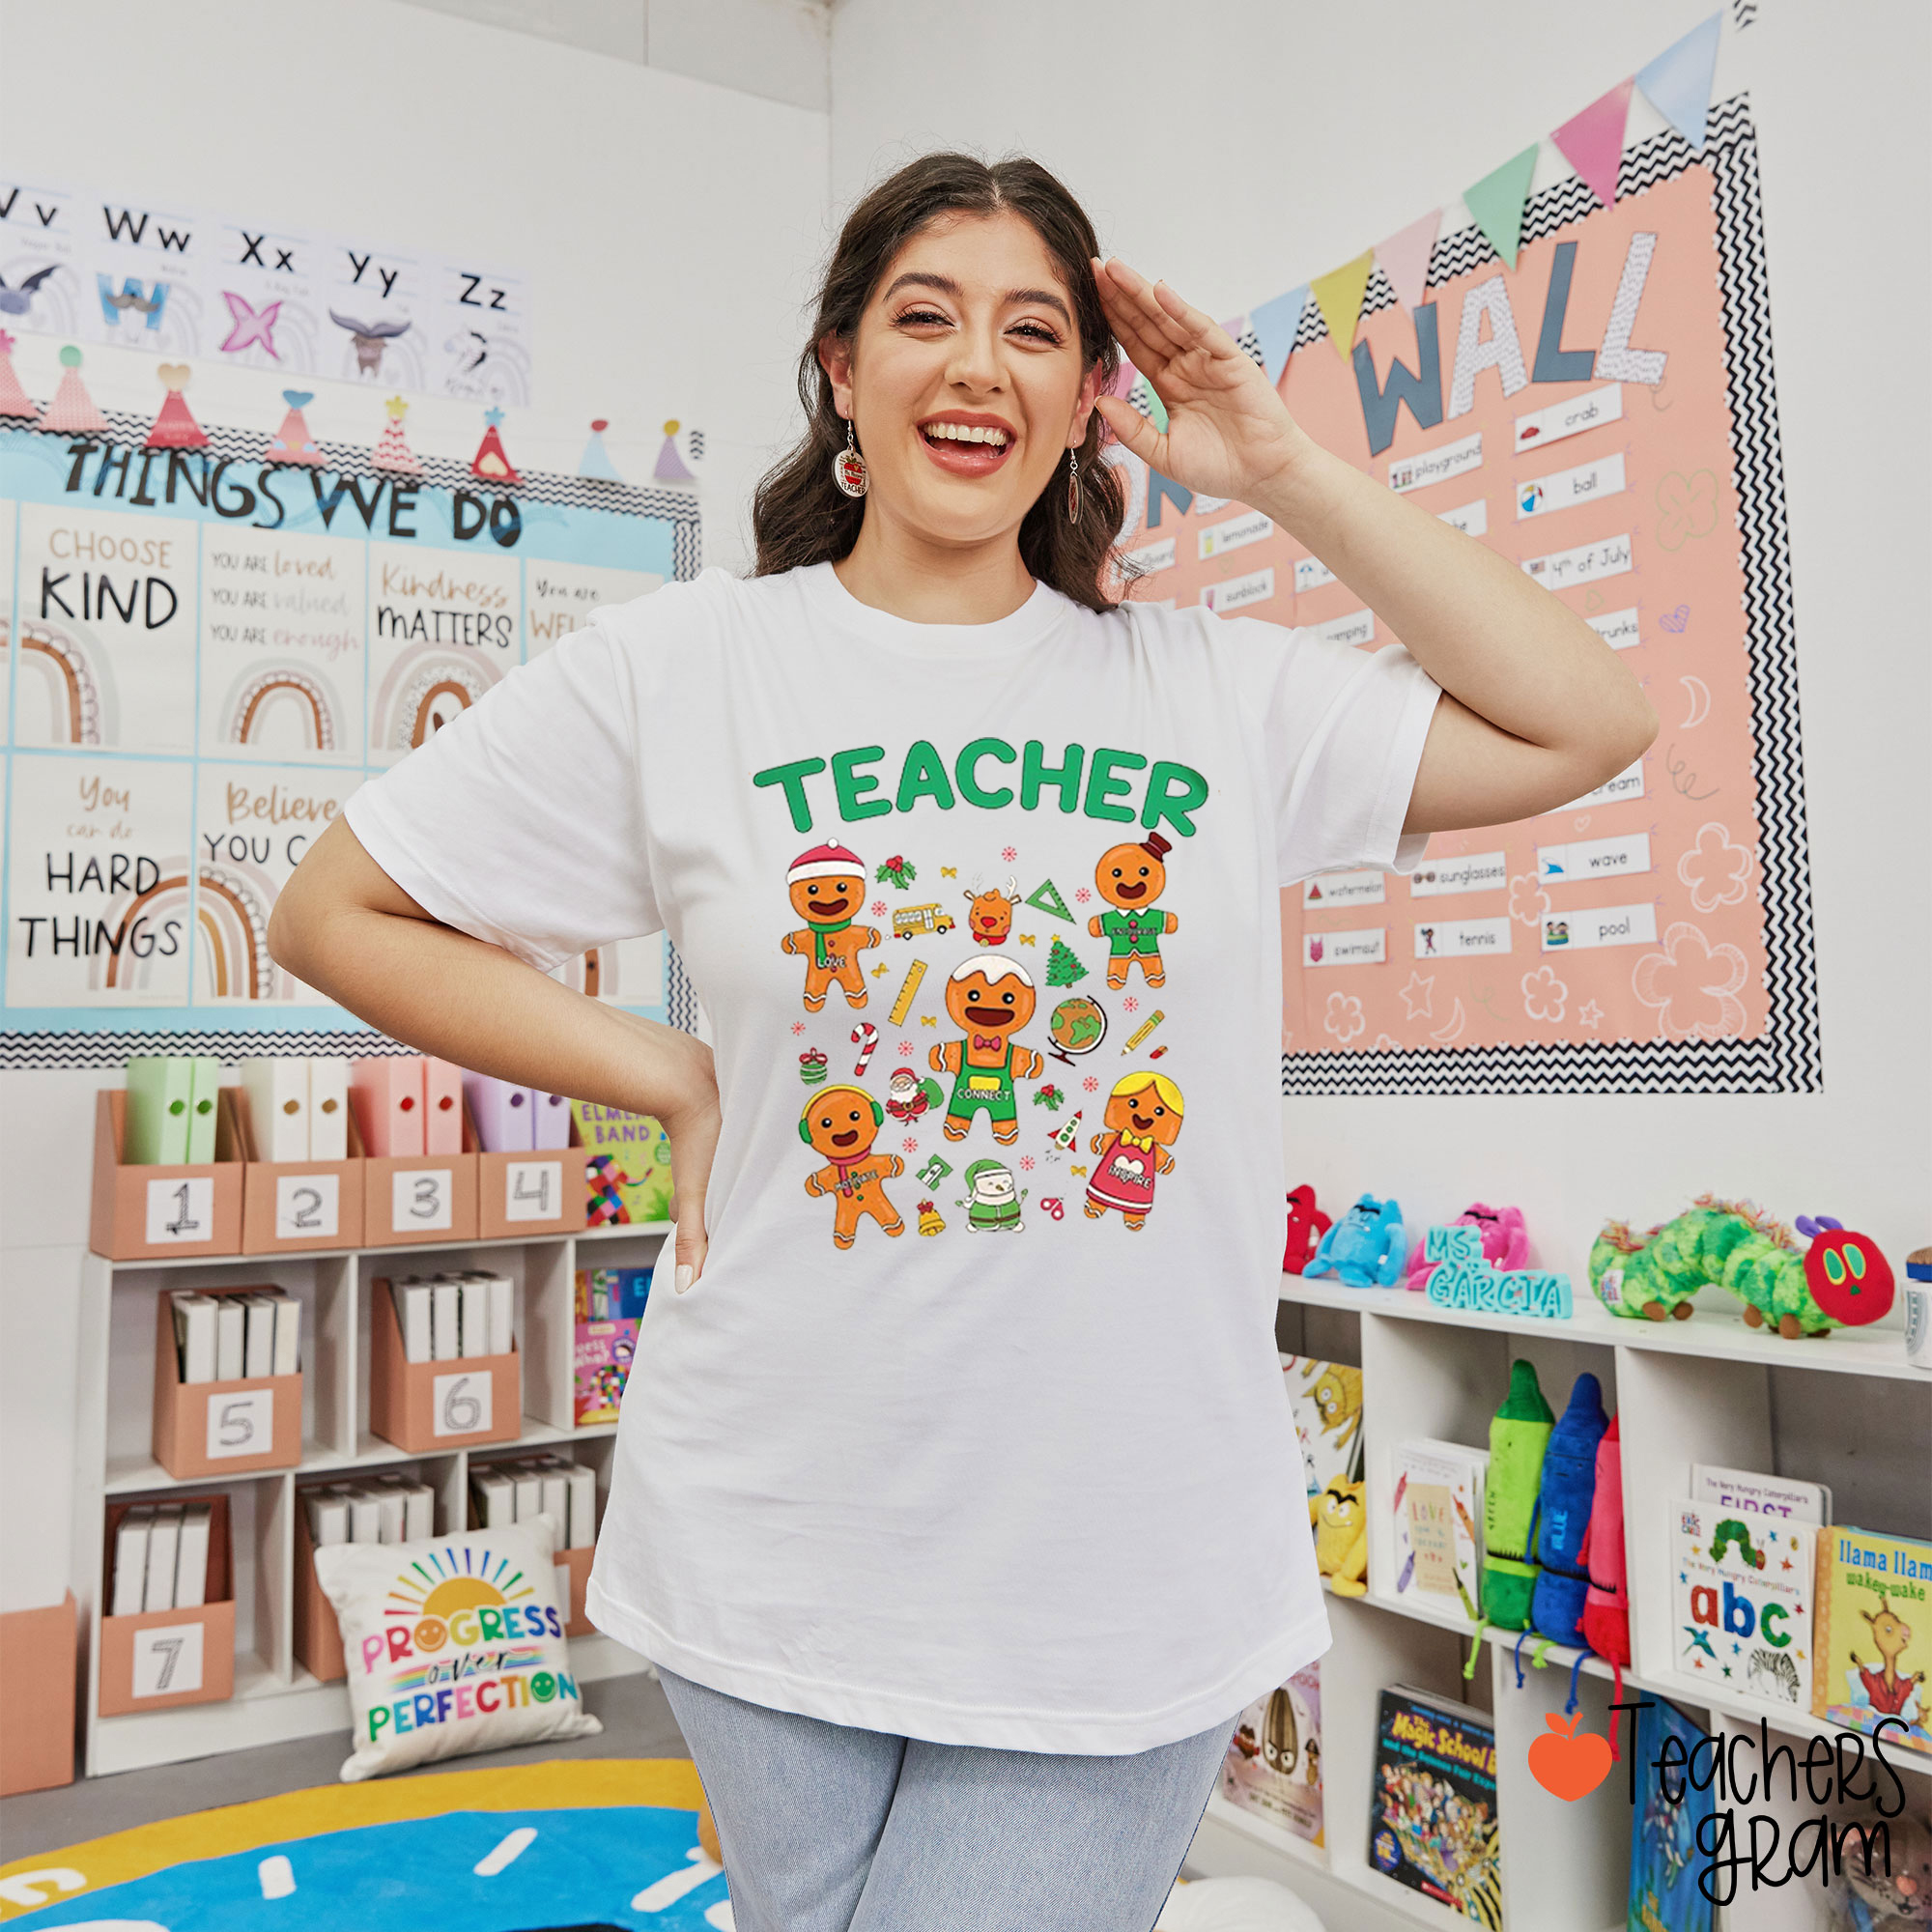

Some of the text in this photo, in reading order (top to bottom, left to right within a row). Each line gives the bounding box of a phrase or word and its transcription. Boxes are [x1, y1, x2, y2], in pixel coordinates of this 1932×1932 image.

[1350, 231, 1669, 458] WALL
[1564, 401, 1599, 426] crab
[1414, 438, 1484, 480] playground
[65, 442, 523, 549] THINGS WE DO
[1572, 470, 1598, 495] ball
[49, 527, 174, 570] CHOOSE
[211, 549, 336, 582] YOU ARE loved
[1577, 552, 1595, 573] of
[1600, 545, 1632, 567] July
[41, 565, 179, 630] KIND
[210, 587, 239, 607] YOU
[242, 589, 268, 610] ARE
[381, 560, 510, 610] Kindness
[210, 623, 360, 663] YOU ARE enough
[79, 775, 131, 812] You
[226, 781, 341, 825] Believe
[753, 737, 1209, 838] TEACHER
[67, 822, 102, 839] can
[204, 833, 270, 865] YOU
[46, 851, 161, 895] HARD
[1438, 863, 1506, 886] sunglasses
[1589, 852, 1628, 868] wave
[18, 915, 183, 958] THINGS
[1459, 929, 1496, 948] tennis
[1598, 915, 1632, 942] pool
[816, 954, 847, 969] LOVE
[956, 1087, 1011, 1101] CONNECT
[594, 1123, 651, 1145] BAND
[410, 1177, 440, 1218] 3
[512, 1169, 549, 1211] 4
[1108, 1165, 1151, 1190] INSPIRE
[164, 1181, 200, 1236] 1
[291, 1186, 324, 1228] 2
[1428, 1264, 1565, 1321] GARCIA
[219, 1401, 254, 1446] 5
[442, 1377, 481, 1431] 6
[1411, 1501, 1444, 1523] LOVE
[1549, 1505, 1569, 1550] BLUE
[1839, 1538, 1888, 1573] llama
[1845, 1571, 1926, 1602] wakey-wake
[1690, 1580, 1793, 1649] abc
[362, 1605, 562, 1676] PROGRESS
[149, 1637, 185, 1690] 7
[426, 1651, 512, 1687] over
[368, 1670, 580, 1744] PERFECTION
[1391, 1710, 1436, 1749] Magic
[1436, 1727, 1488, 1772] School
